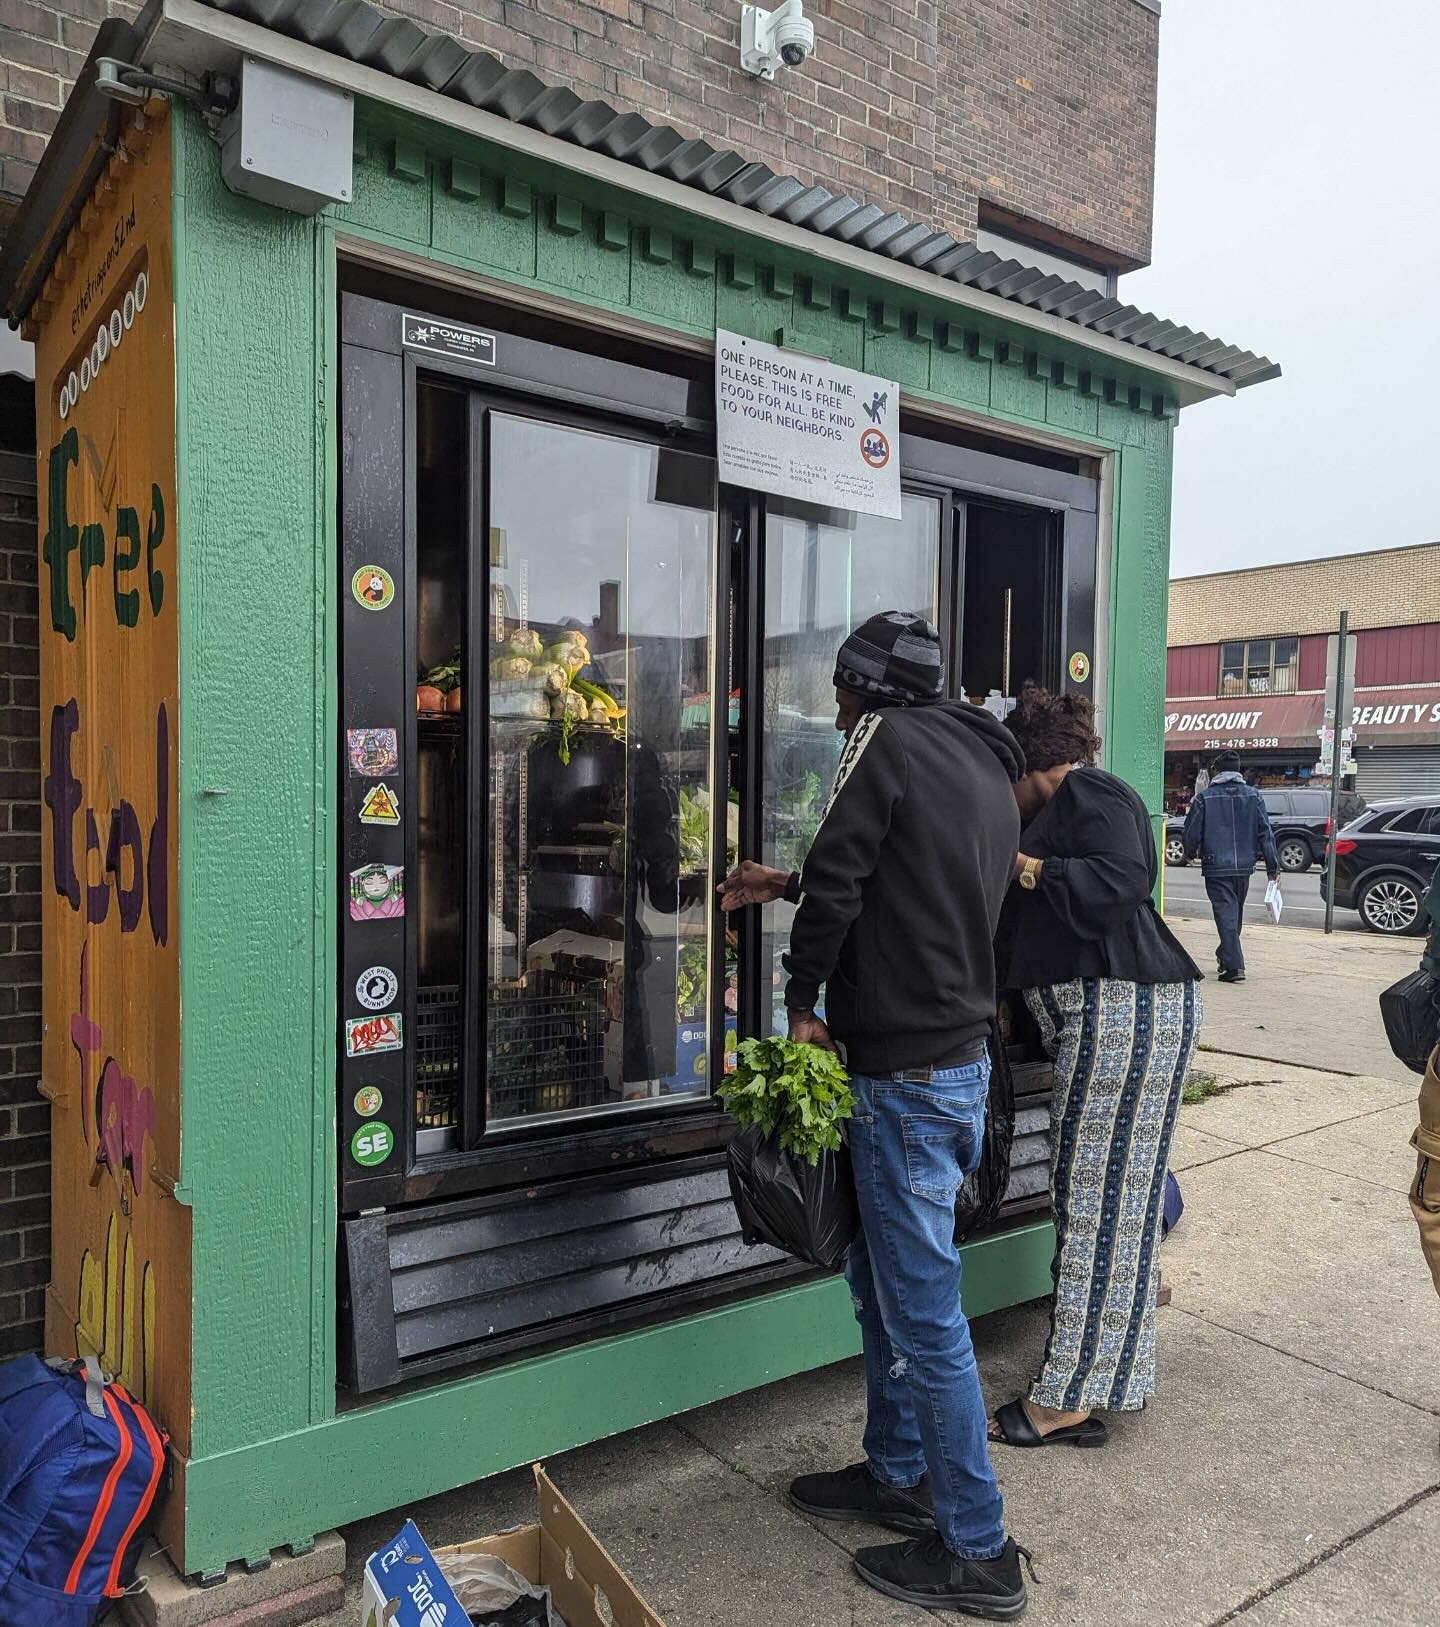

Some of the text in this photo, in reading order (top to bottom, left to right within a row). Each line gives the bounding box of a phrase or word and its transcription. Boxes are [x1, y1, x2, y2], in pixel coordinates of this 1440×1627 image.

[430, 326, 490, 346] POWERS
[721, 348, 855, 399] ONE PERSON AT A TIME,
[721, 365, 842, 409] PLEASE. THIS IS FREE
[721, 382, 855, 428] FOOD FOR ALL. BE KIND
[721, 398, 844, 442] TO YOUR NEIGHBORS.
[43, 427, 165, 642] free
[1177, 712, 1263, 731] DISCOUNT
[1352, 704, 1429, 725] BEAUTY
[1204, 738, 1279, 749] 215-476-3828
[361, 968, 395, 984] WEST PHILLY
[363, 988, 396, 1007] BUNNY HOP
[356, 1132, 388, 1157] SE
